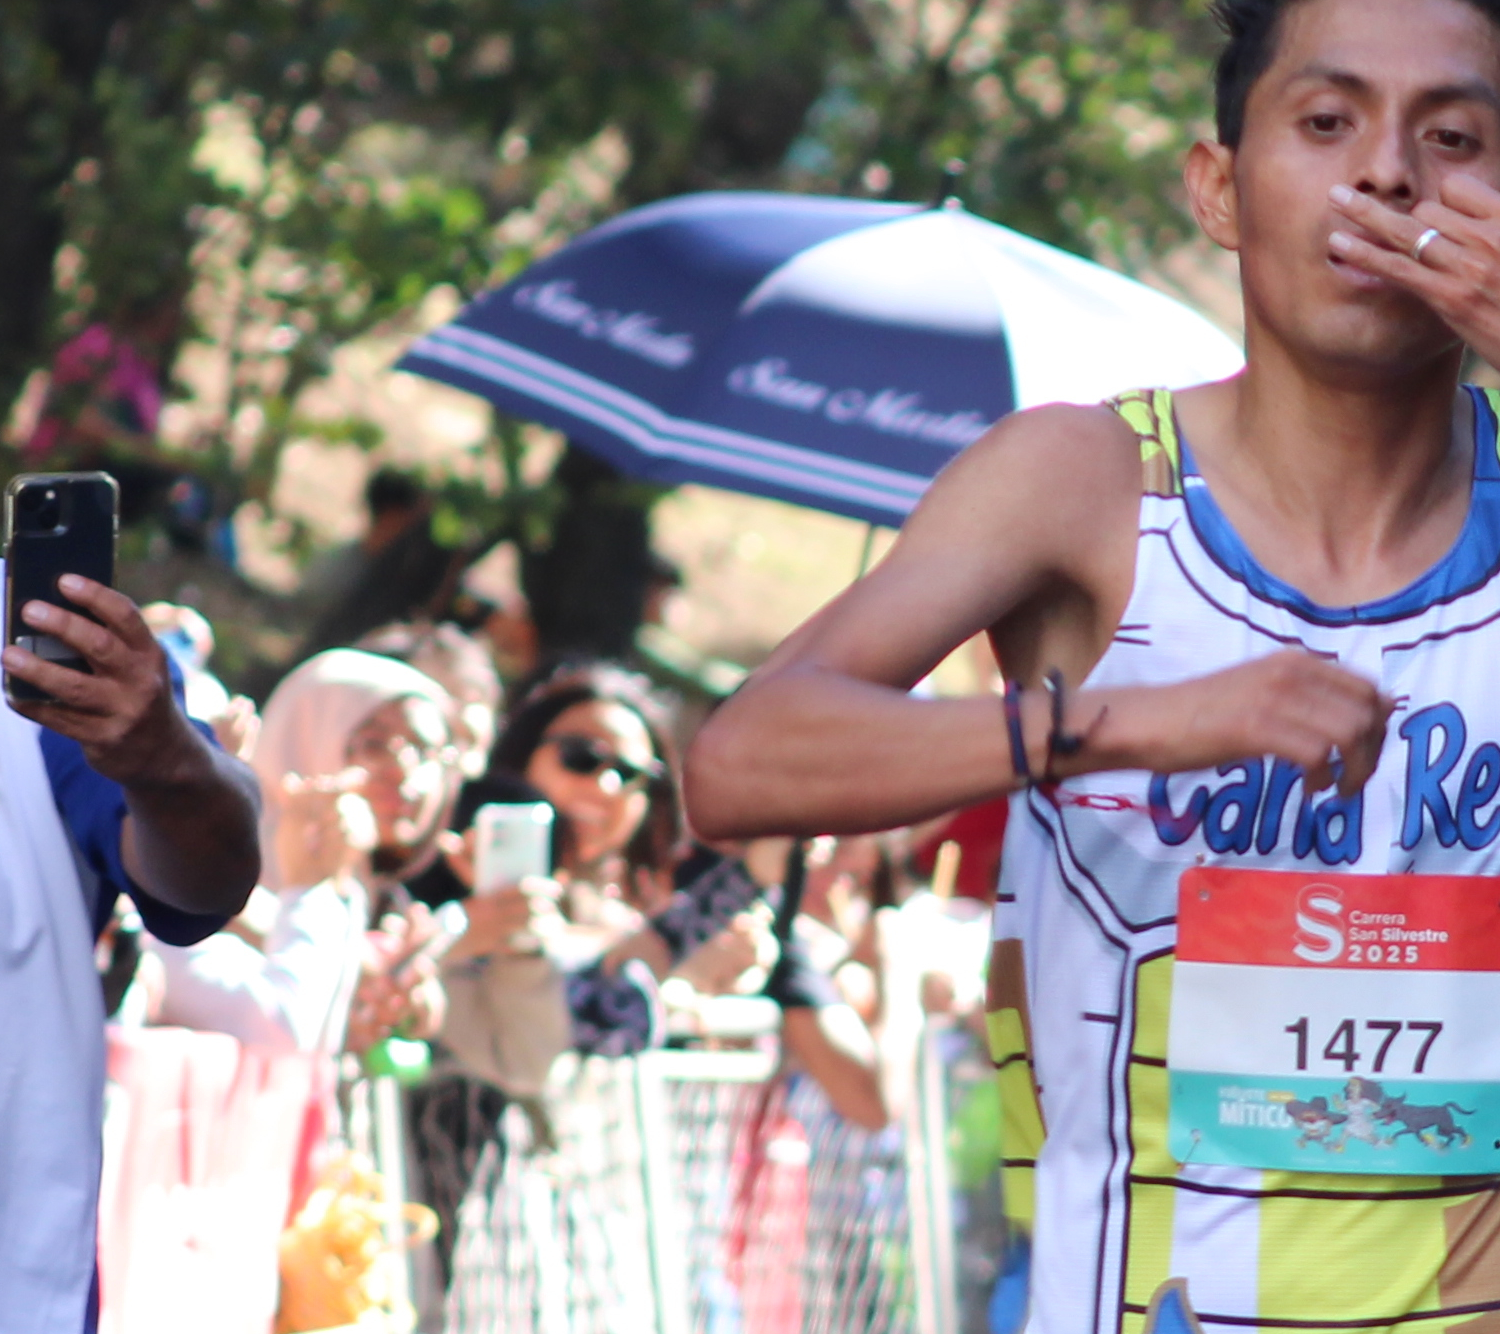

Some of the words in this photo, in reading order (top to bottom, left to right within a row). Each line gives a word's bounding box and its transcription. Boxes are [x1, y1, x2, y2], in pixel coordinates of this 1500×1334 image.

[727, 357, 828, 411] San
[1349, 910, 1407, 925] Carrera
[1349, 927, 1378, 941] San
[1381, 928, 1449, 943] Silvestre
[1348, 945, 1418, 963] 2025
[1284, 1016, 1444, 1074] 1477
